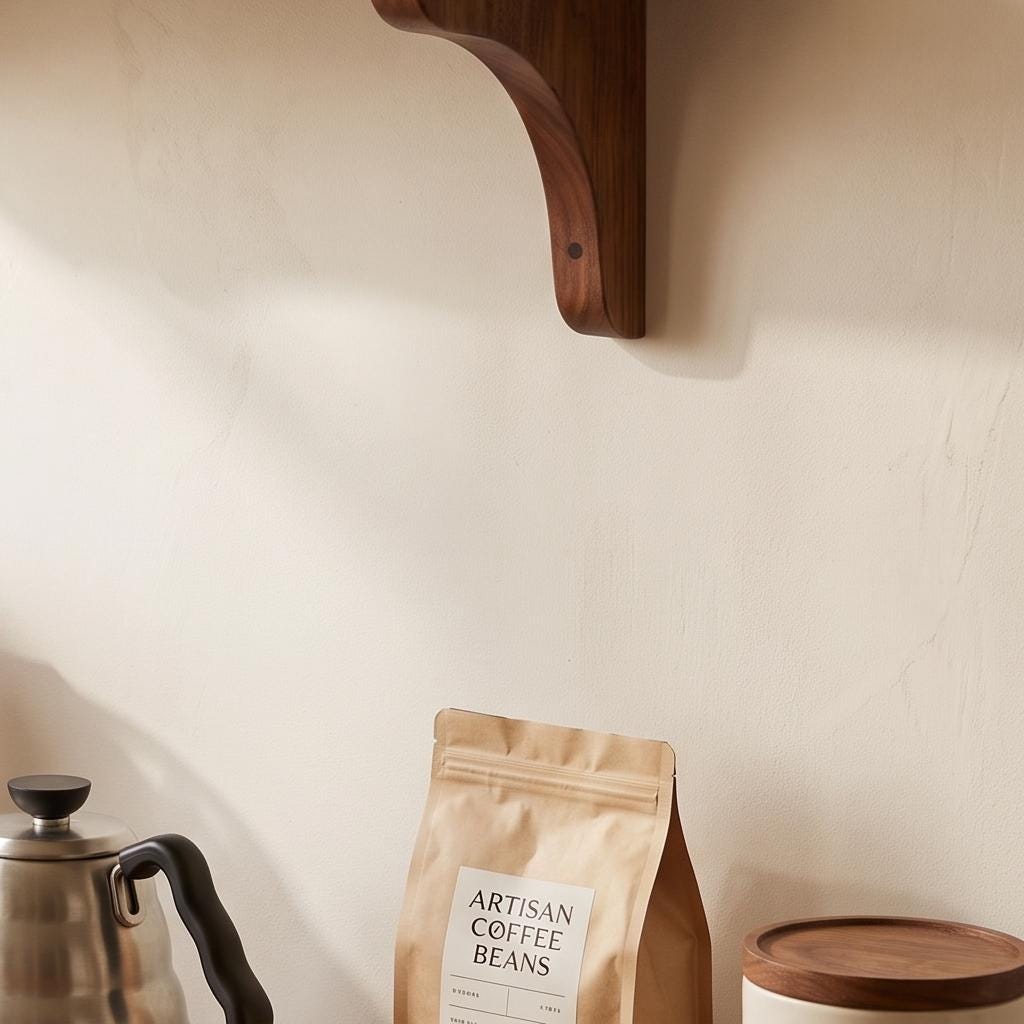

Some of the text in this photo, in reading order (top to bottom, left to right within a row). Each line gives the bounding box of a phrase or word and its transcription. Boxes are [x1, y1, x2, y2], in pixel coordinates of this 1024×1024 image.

[469, 890, 573, 925] ARTISAN
[471, 917, 563, 950] COFFEE
[473, 944, 550, 976] BEANS
